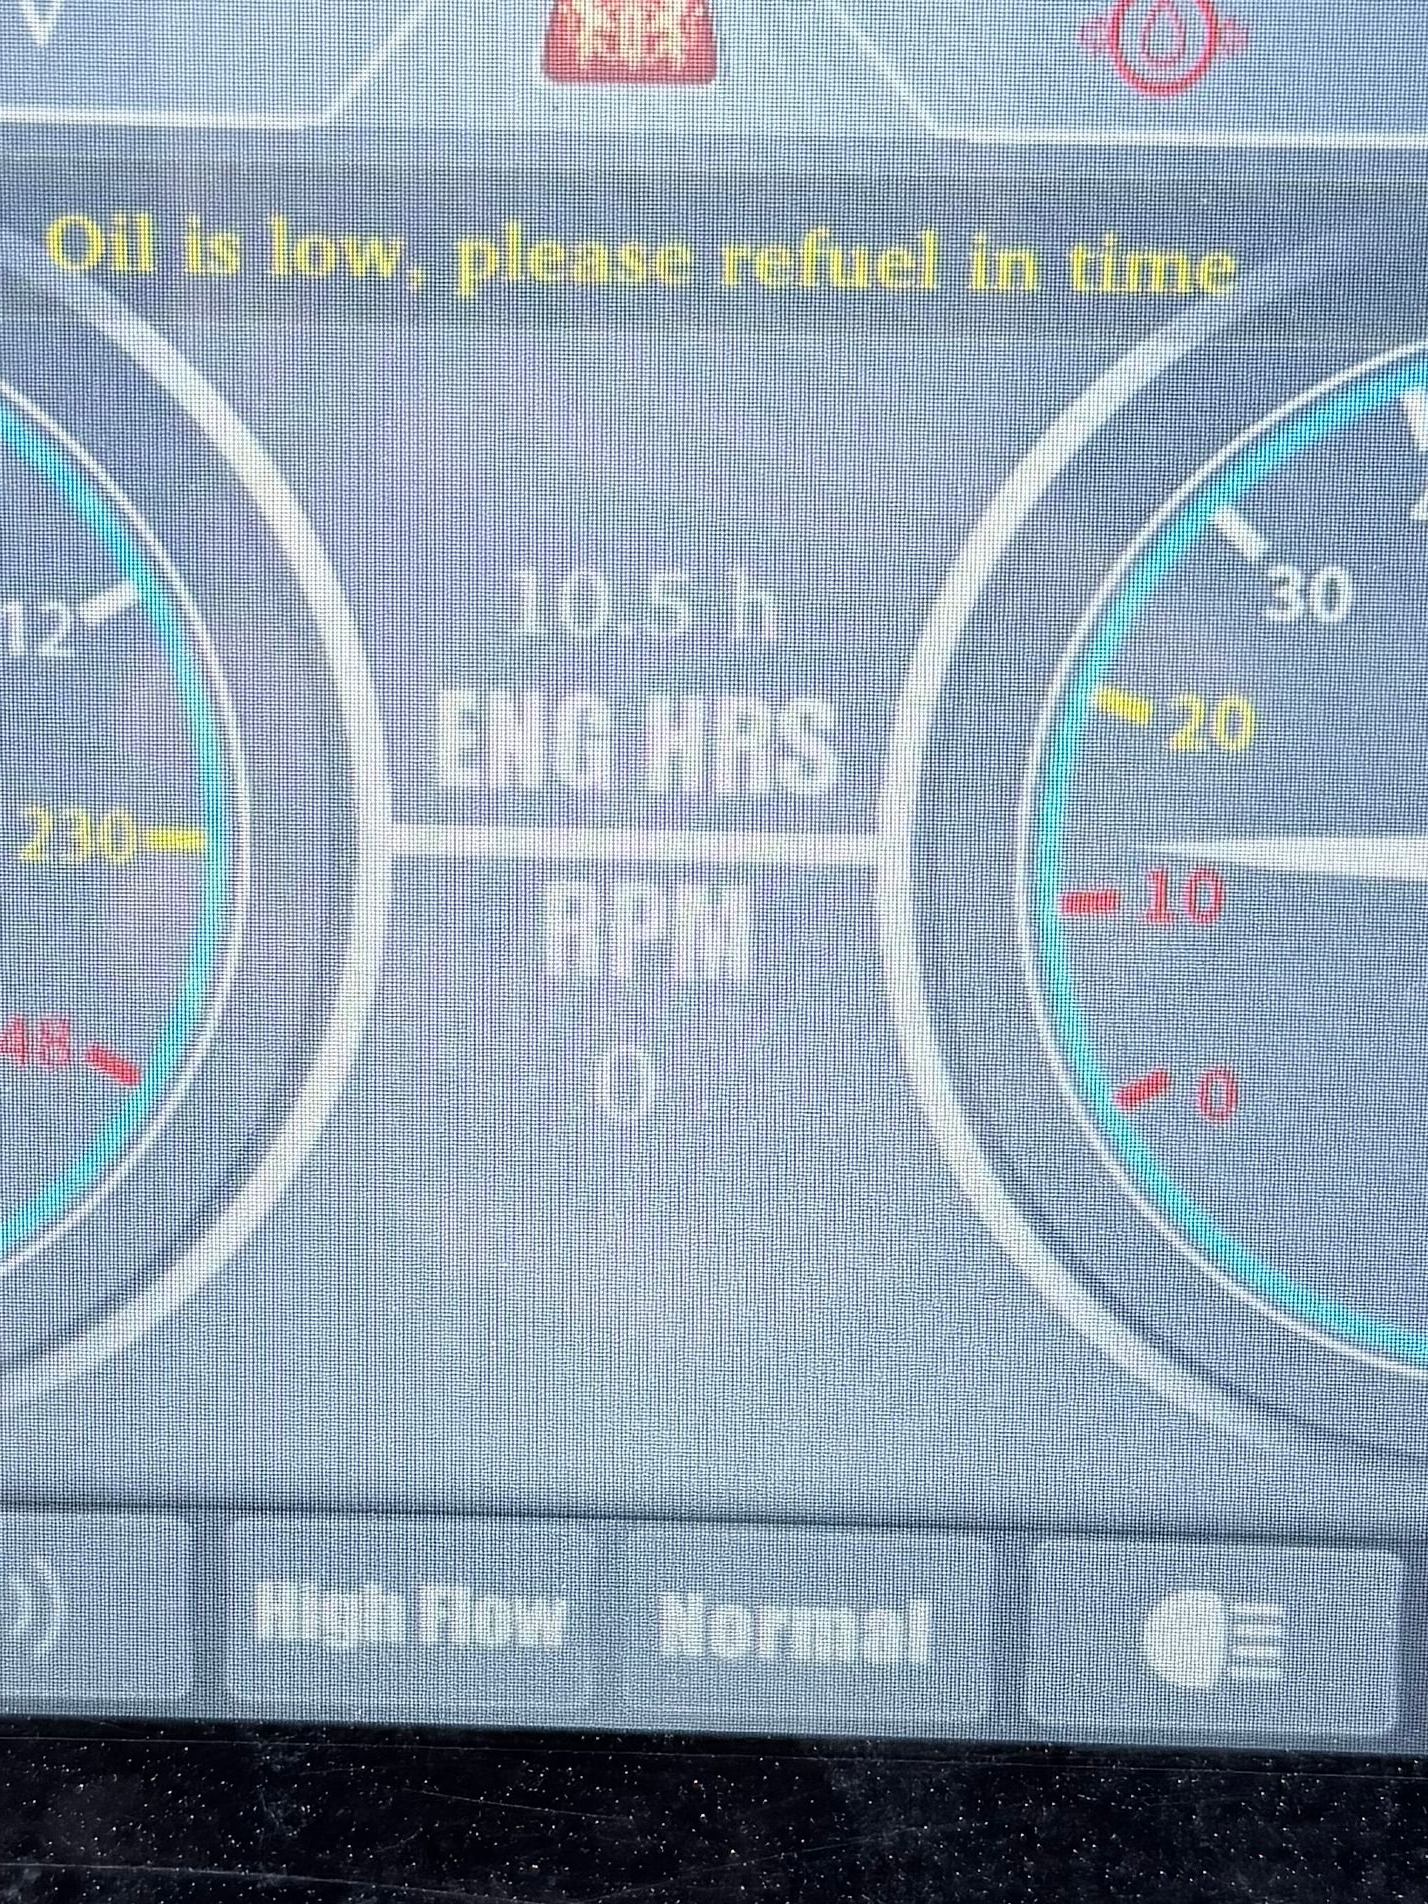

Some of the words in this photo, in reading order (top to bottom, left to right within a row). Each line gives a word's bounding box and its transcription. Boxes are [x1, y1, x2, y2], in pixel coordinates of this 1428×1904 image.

[46, 212, 155, 277] Oil
[183, 218, 239, 277] is
[270, 212, 426, 293] low,
[457, 218, 693, 298] please
[720, 229, 939, 295] refuel
[971, 235, 1038, 295] in
[1066, 235, 1238, 298] time
[512, 566, 702, 641] 10.5
[732, 568, 778, 642] h
[1264, 563, 1354, 624] 30
[438, 688, 617, 794] ENG
[646, 694, 839, 793] HRS
[1166, 694, 1256, 753] 20
[20, 809, 136, 865] 230
[542, 878, 754, 988] RPM
[1143, 867, 1225, 925] 10
[592, 1041, 657, 1126] 0
[1195, 1068, 1240, 1123] 0
[257, 1576, 405, 1647] High
[422, 1581, 568, 1654] Flow
[661, 1593, 930, 1669] Normal
